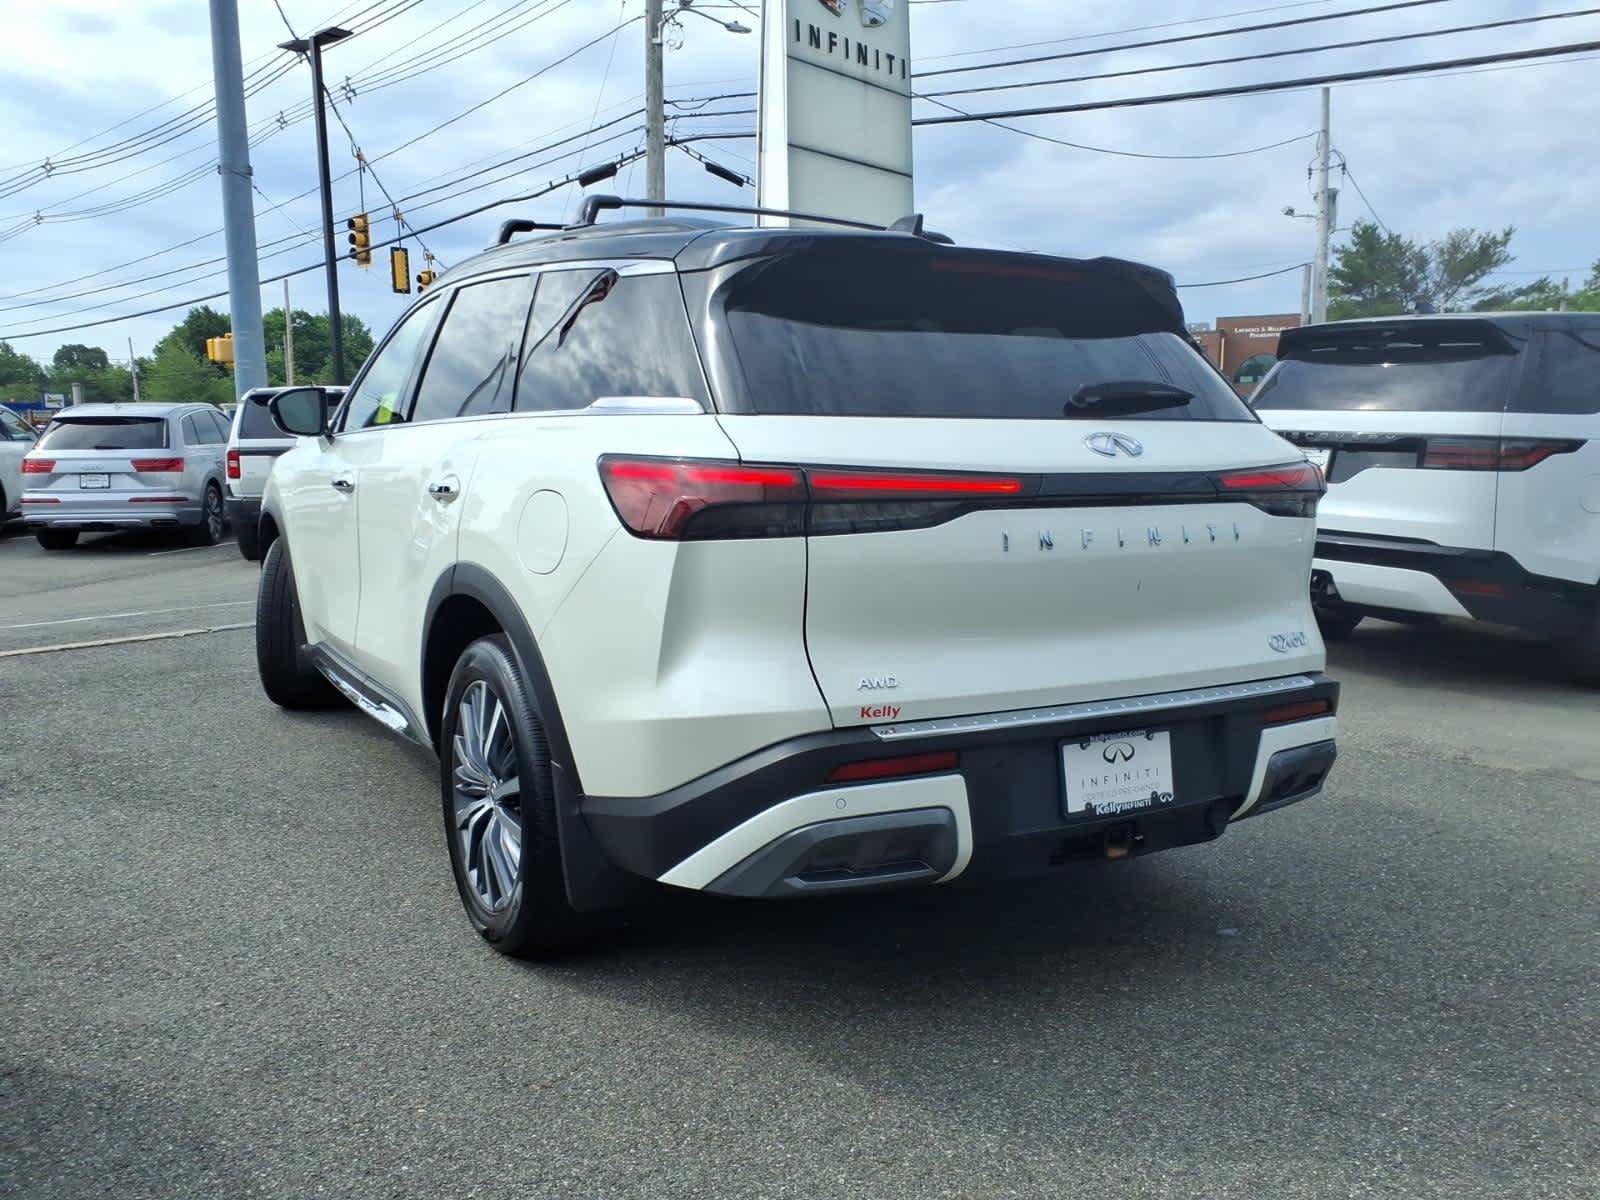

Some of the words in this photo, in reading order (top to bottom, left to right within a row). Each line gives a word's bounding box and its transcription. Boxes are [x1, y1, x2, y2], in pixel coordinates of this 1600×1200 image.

[794, 19, 906, 79] INFINITI
[1000, 520, 1240, 551] INFINITI
[857, 674, 900, 690] AWD
[860, 704, 902, 720] Kelly
[1080, 767, 1160, 789] INFINITI
